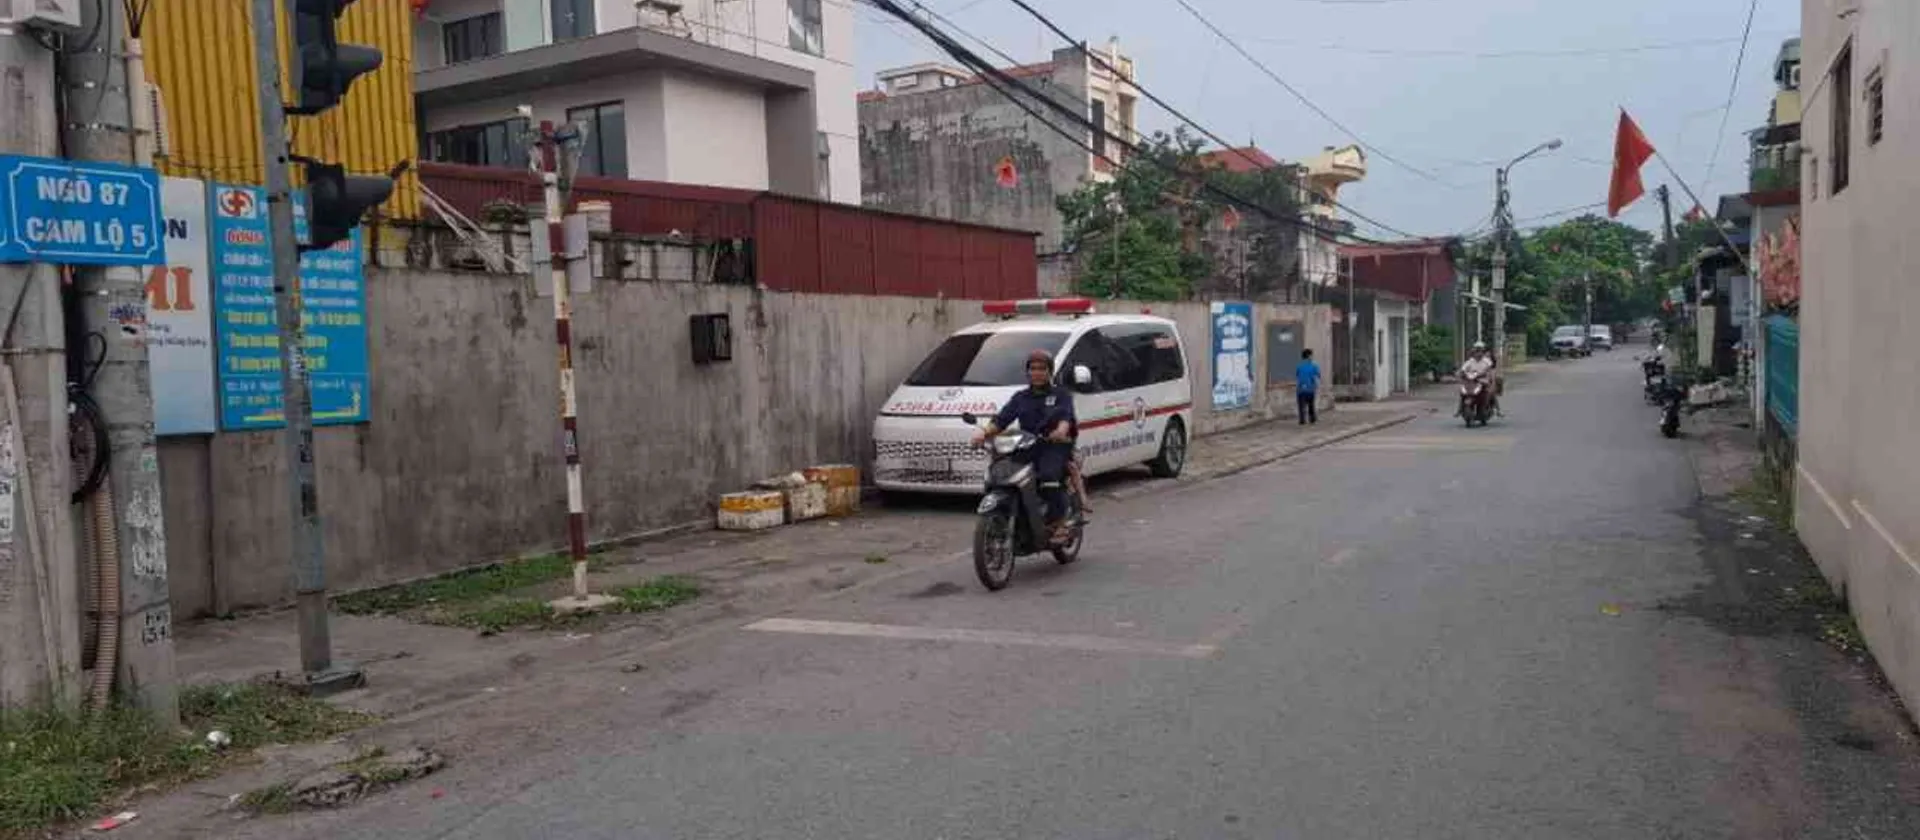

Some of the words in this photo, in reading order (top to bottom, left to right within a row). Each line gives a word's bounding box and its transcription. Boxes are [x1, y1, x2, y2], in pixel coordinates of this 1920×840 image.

[36, 175, 92, 203] NGÕ
[100, 181, 129, 206] 87
[26, 216, 87, 244] CAM
[94, 217, 125, 251] LỘ
[131, 224, 147, 248] 5
